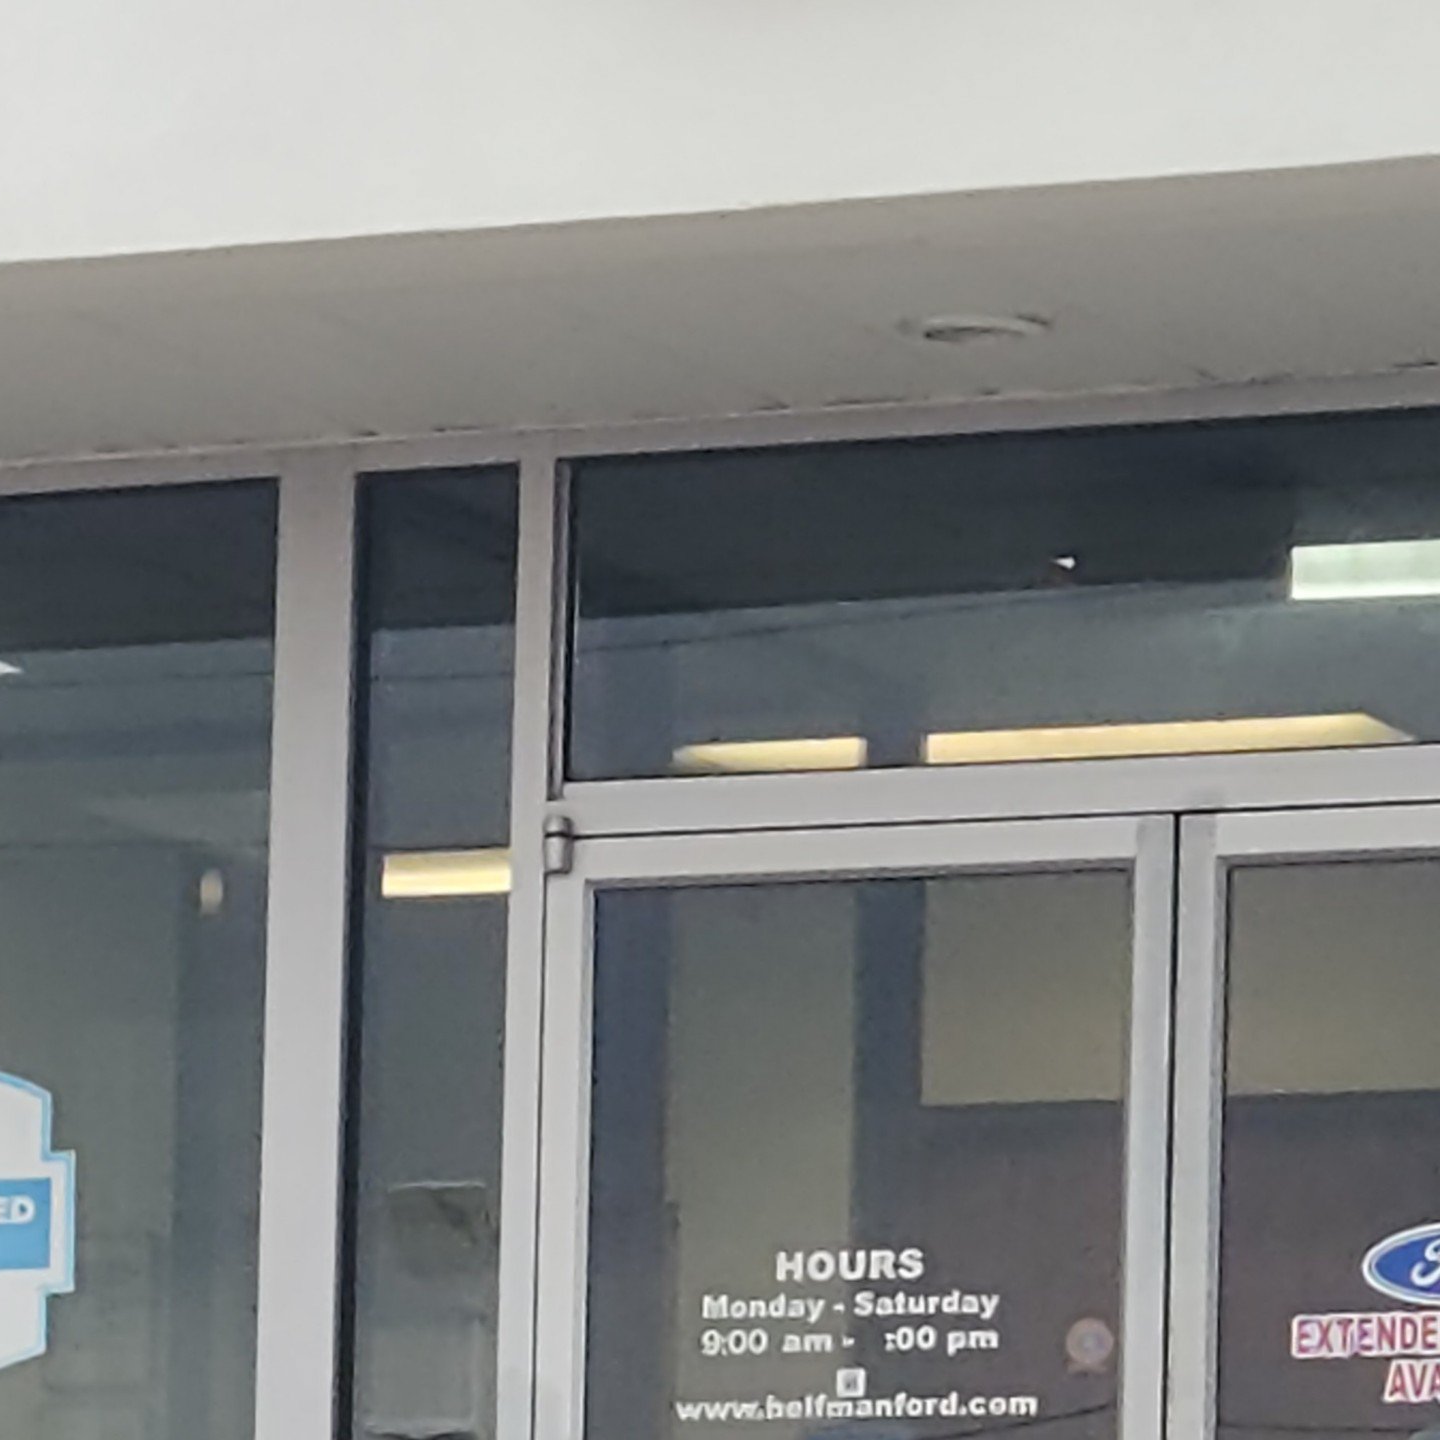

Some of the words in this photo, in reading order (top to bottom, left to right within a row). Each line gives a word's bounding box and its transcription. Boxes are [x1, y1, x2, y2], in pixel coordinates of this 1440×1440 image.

[776, 1248, 926, 1283] HOURS
[701, 1293, 826, 1323] Monday
[853, 1290, 1000, 1320] Saturday
[701, 1328, 769, 1356] 9:00
[782, 1333, 833, 1354] am
[947, 1329, 1000, 1357] pm
[676, 1391, 1040, 1421] www.helfmanford.com
